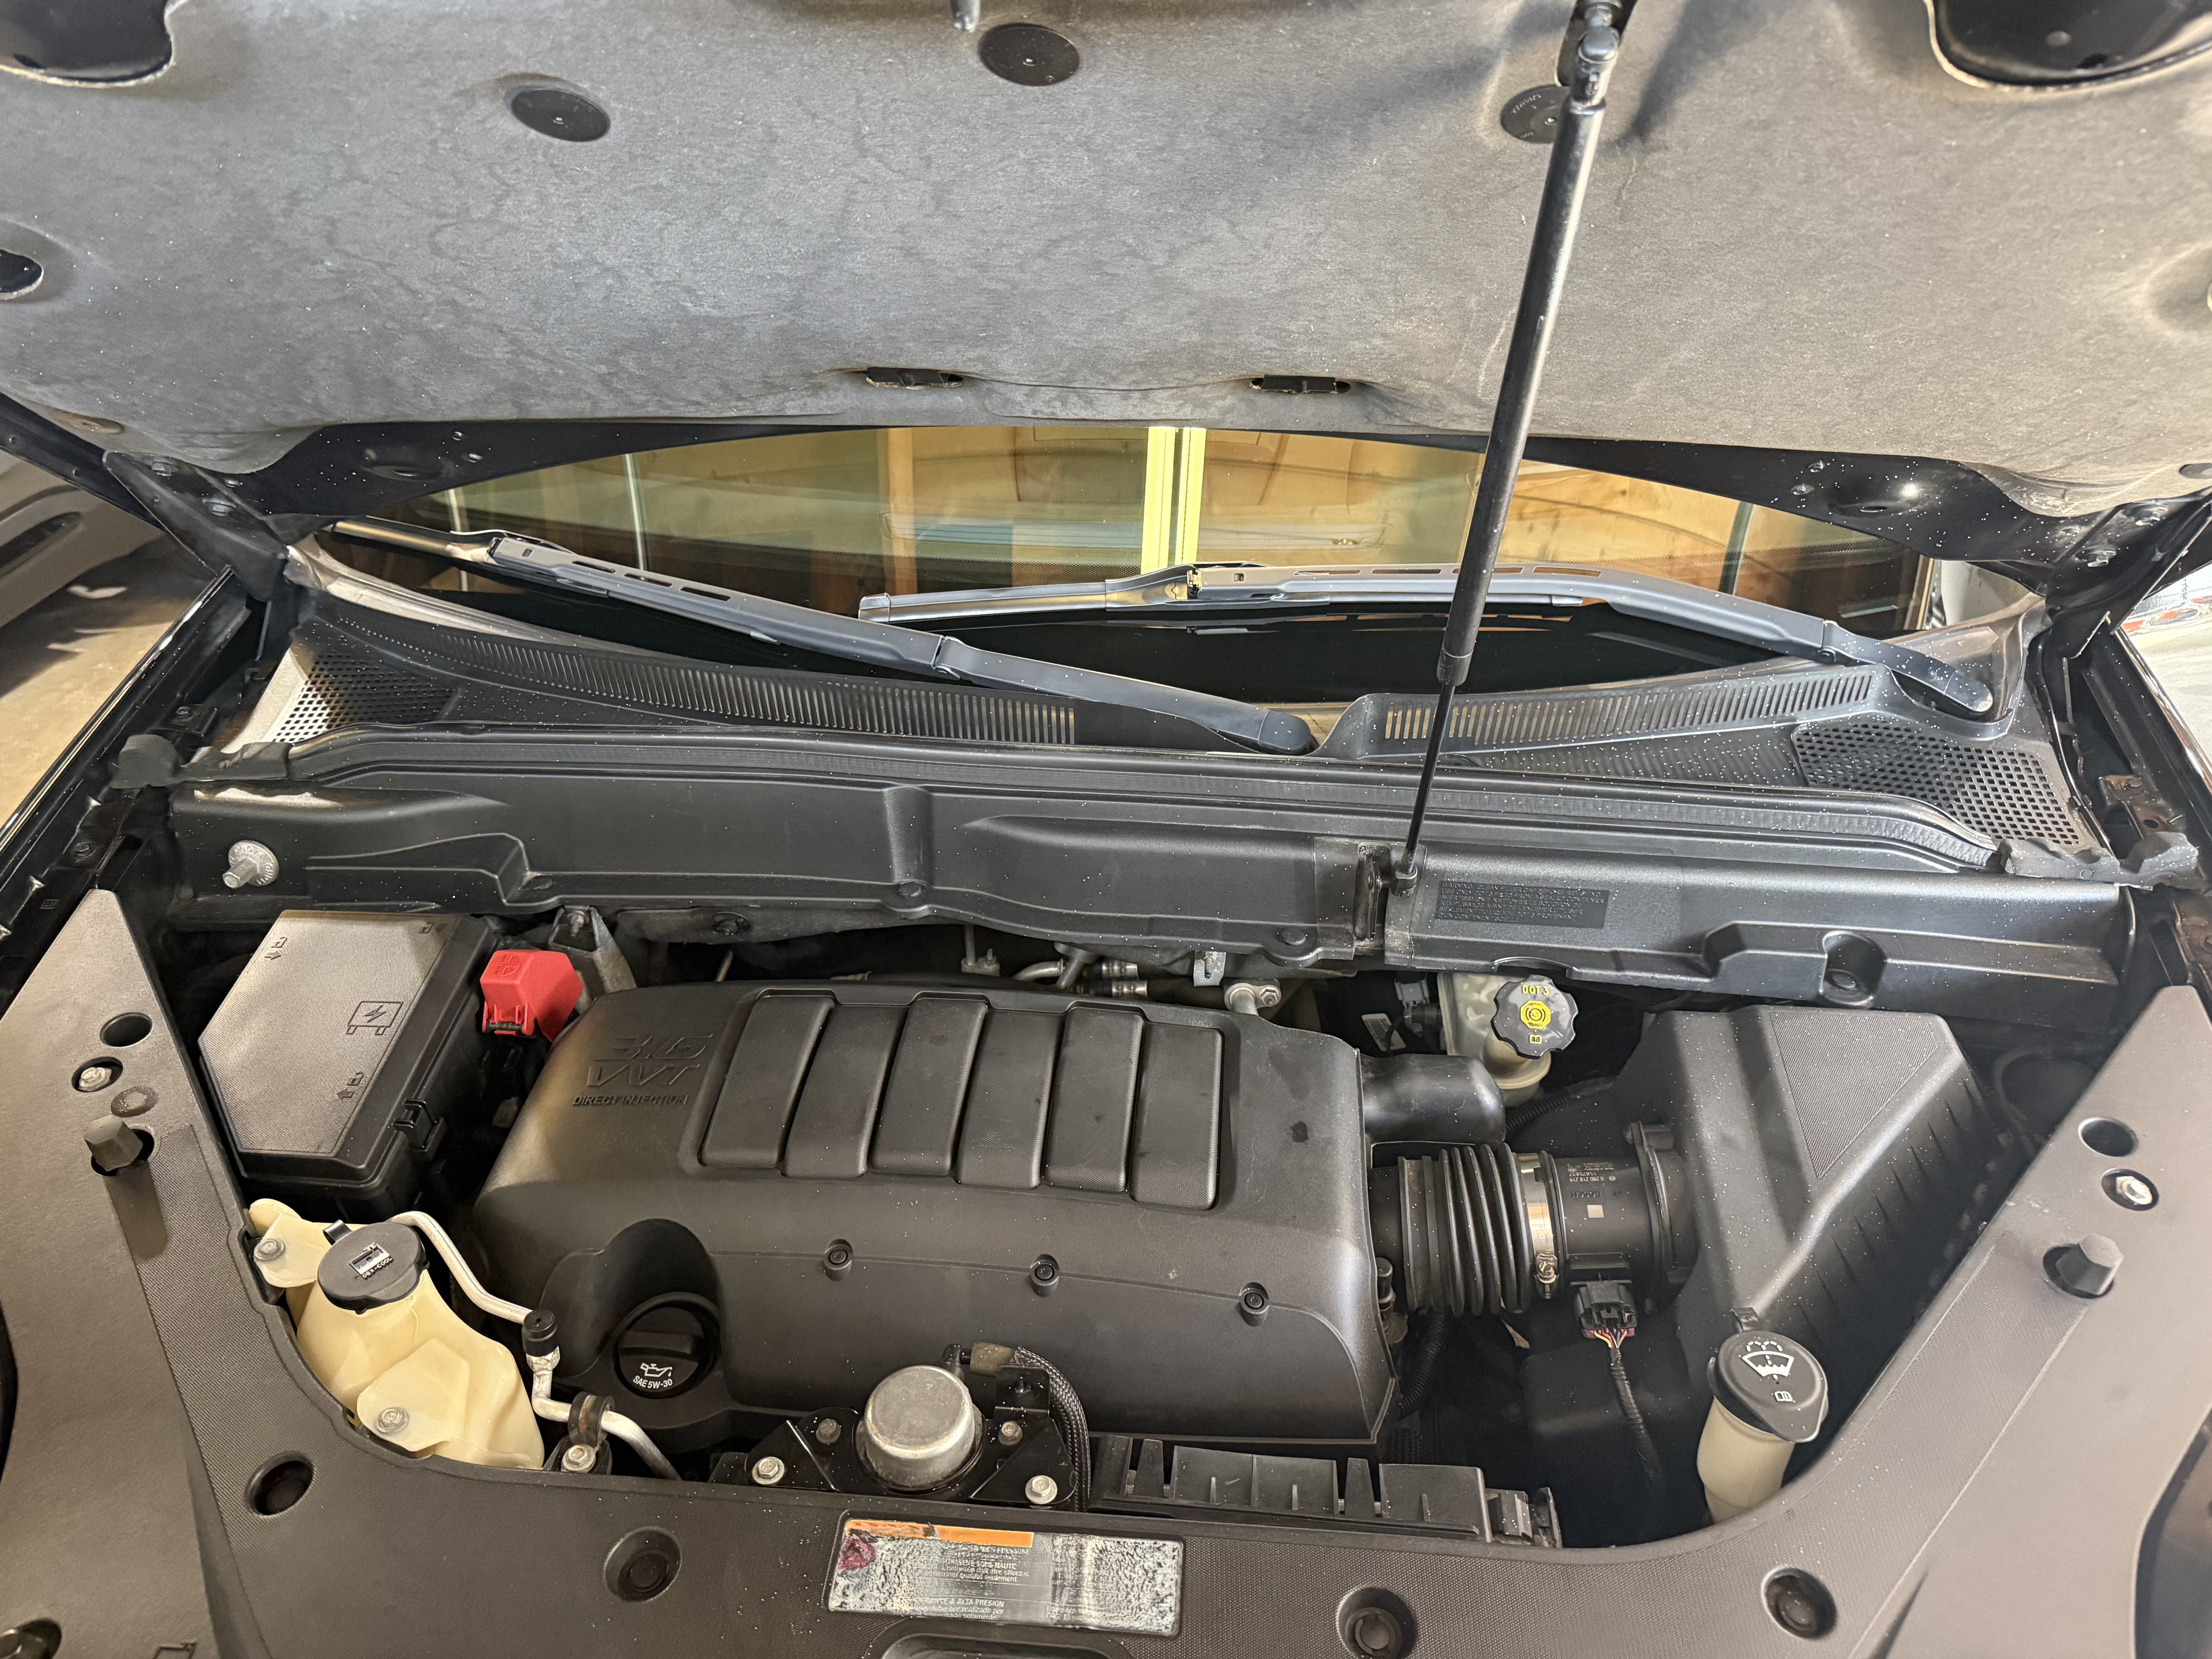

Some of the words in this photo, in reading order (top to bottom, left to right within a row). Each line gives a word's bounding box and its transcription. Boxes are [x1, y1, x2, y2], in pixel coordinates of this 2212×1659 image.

[1522, 985, 1541, 995] DOT
[1543, 986, 1549, 996] 3
[594, 1034, 713, 1061] 3.6
[586, 1064, 701, 1087] VVT
[572, 1095, 621, 1106] DIRECT
[622, 1094, 689, 1106] INJECTION
[362, 1257, 393, 1279] DEX-COOL
[633, 1375, 648, 1388] SAE
[647, 1378, 673, 1389] 5W-30
